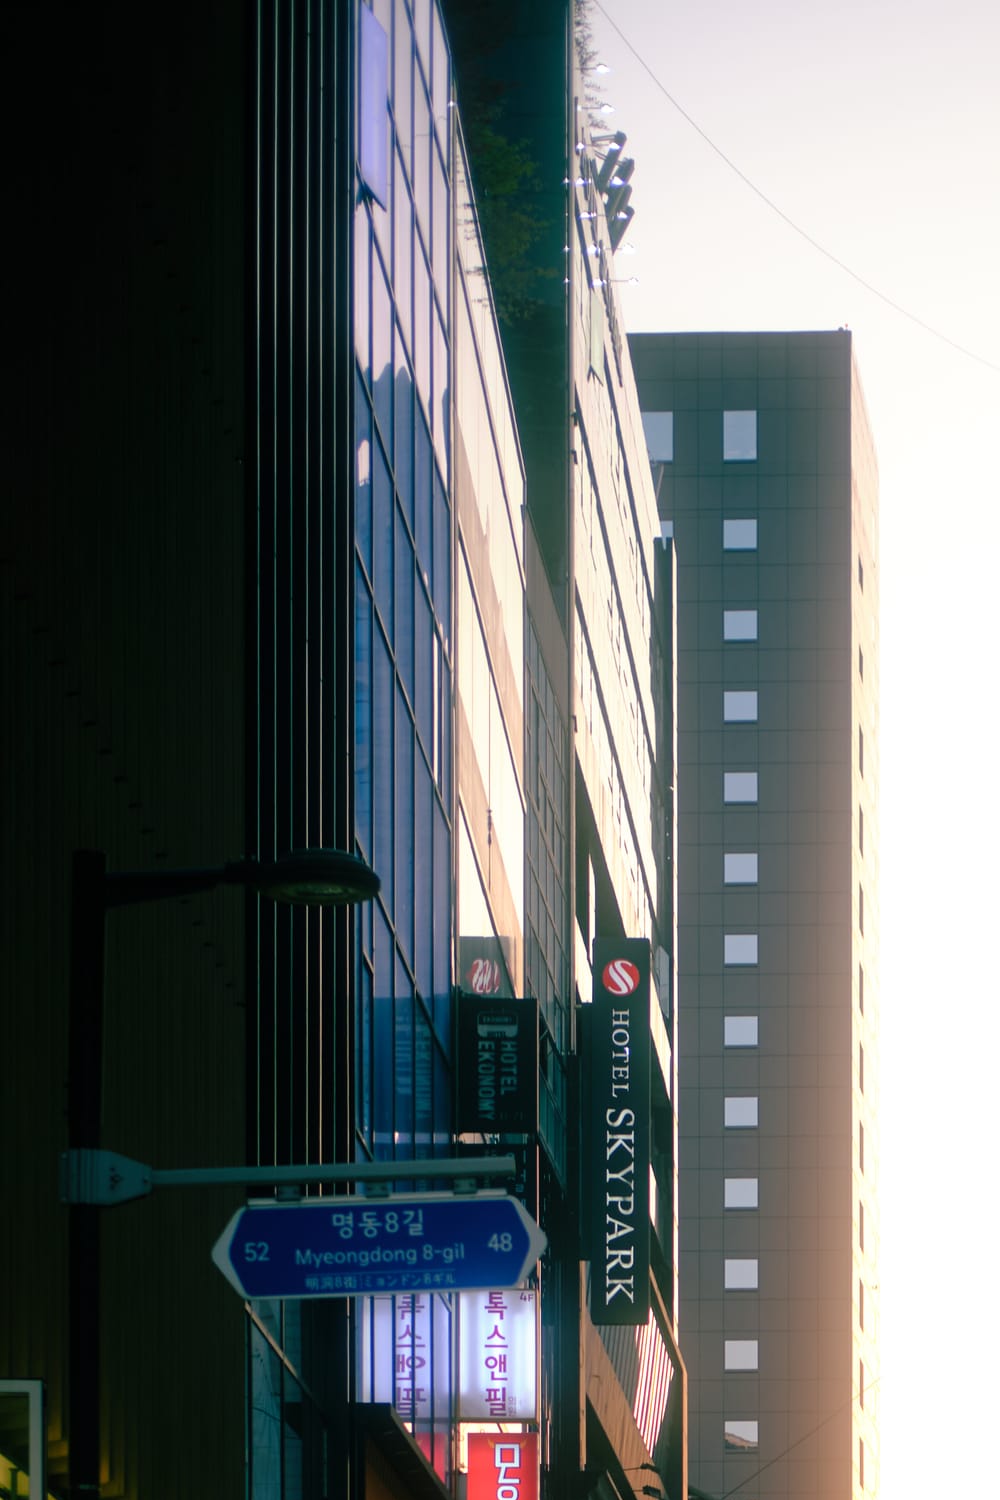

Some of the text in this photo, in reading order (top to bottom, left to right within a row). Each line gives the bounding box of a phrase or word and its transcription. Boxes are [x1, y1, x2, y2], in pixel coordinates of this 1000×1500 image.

[500, 1041, 517, 1096] HOTEL
[605, 1007, 635, 1306] HOTEL SKYPARK
[331, 1209, 425, 1239] 명동8길
[244, 1242, 270, 1262] 52
[295, 1243, 465, 1269] Myeongdong 8-gil
[487, 1233, 513, 1252] 48
[519, 1292, 534, 1302] 4F
[484, 1291, 509, 1417] 톡스앤필
